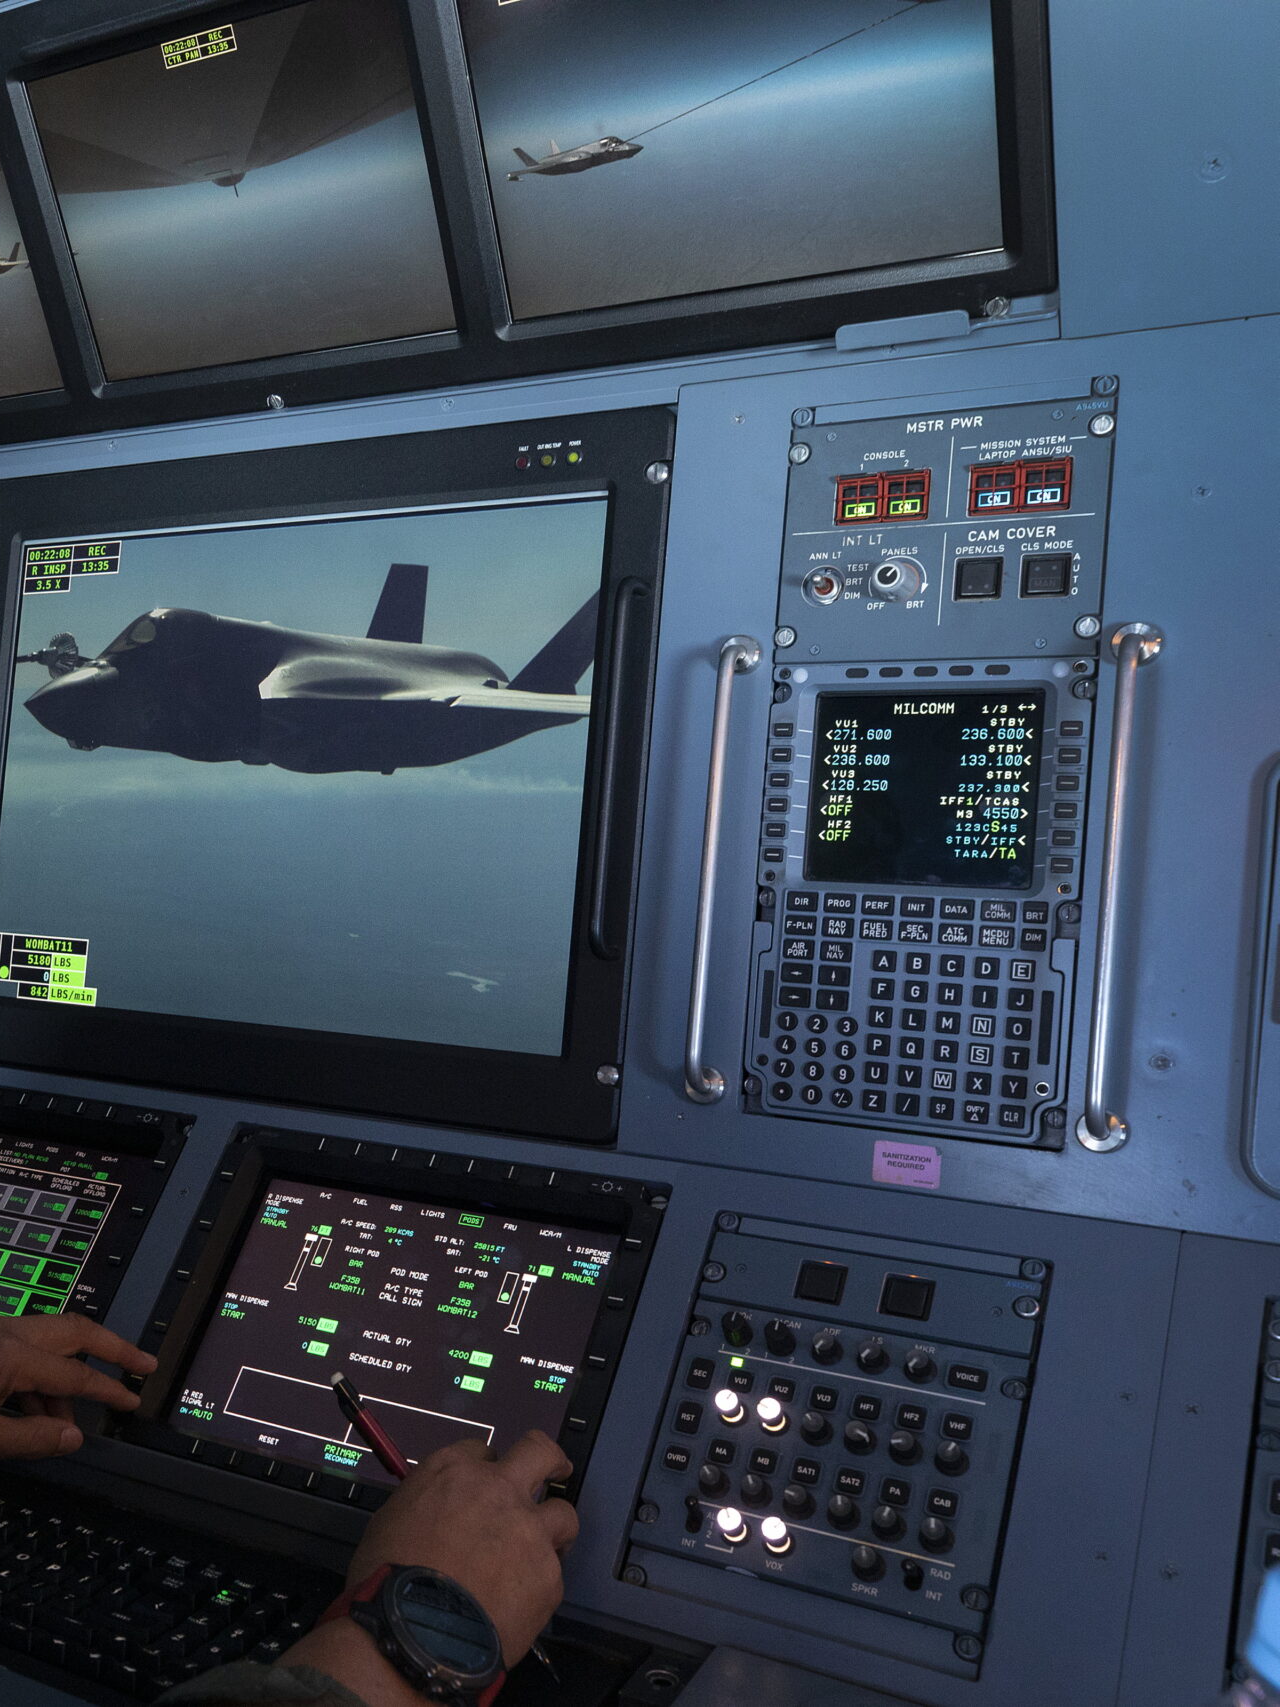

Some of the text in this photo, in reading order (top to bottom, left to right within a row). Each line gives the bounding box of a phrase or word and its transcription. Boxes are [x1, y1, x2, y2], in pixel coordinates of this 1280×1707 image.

[164, 31, 223, 54] 00:22:08 REC
[168, 41, 229, 65] CTR PAN 13:35
[906, 415, 983, 434] MSTR PWR
[980, 435, 1067, 451] MISSION SYSTEM
[863, 449, 906, 461] CONSOLE
[979, 445, 1073, 461] LAPTOP ANSU/SIU
[968, 525, 1057, 542] CAM COVER
[842, 534, 884, 547] INT LT
[1021, 540, 1074, 552] CLS MODE
[29, 546, 106, 561] 00:22:08 REC
[881, 547, 918, 557] PANELS
[955, 543, 1005, 555] OPEN/CLS
[809, 551, 842, 560] ANN LT
[32, 561, 109, 575] R INSP 13:35
[847, 563, 869, 572] TEST
[36, 579, 61, 590] 3.5 X
[845, 577, 863, 586] BRT
[844, 592, 861, 600] DIM
[867, 602, 885, 611] OFF
[906, 600, 925, 610] BRT
[893, 702, 1008, 715] MILCOMM 1/3
[835, 720, 859, 729] VU1
[990, 718, 1025, 727] STBY
[833, 744, 857, 753] VU2
[988, 744, 1024, 754] STBY
[832, 770, 855, 779] VU3
[986, 770, 1022, 780] STBY
[830, 795, 853, 804] HF1
[940, 794, 1020, 806] IFF1/TCAS
[956, 810, 974, 819] M3
[827, 820, 852, 829] HF2
[954, 847, 1017, 860] TARA/TA
[794, 896, 809, 906] DIR
[827, 898, 851, 909] PROG
[865, 901, 889, 910] PERF
[907, 903, 926, 912] INIT
[945, 905, 968, 915] DATA
[1026, 911, 1044, 921] BRT
[786, 920, 813, 930] F-PLN
[983, 928, 1010, 939] MCDU
[1025, 932, 1042, 942] DIM
[25, 938, 73, 952] WOMBAT11
[982, 936, 1009, 946] MENU
[28, 954, 71, 967] 5180 LBS
[43, 971, 70, 983] 0 LBS
[30, 986, 92, 1002] 842 LBS/min
[1003, 1111, 1019, 1123] CLR
[882, 1151, 932, 1164] SANITIZATION
[887, 1160, 925, 1171] REQUIRED
[352, 1198, 368, 1206] FUEL
[390, 1204, 403, 1212] RSS
[420, 1209, 445, 1219] LIGHTS
[260, 1217, 288, 1229] MANUAL
[462, 1216, 480, 1225] PODS
[340, 1218, 353, 1227] A/C
[355, 1221, 377, 1231] SPEED:
[397, 1228, 415, 1237] KCAS
[503, 1222, 518, 1231] FRU
[434, 1235, 506, 1254] STD ALT: 25815 FT
[344, 1245, 380, 1258] RIGHT POD
[348, 1259, 364, 1268] BAR
[390, 1267, 429, 1281] POD MODE
[454, 1266, 489, 1279] LEFT POD
[561, 1272, 596, 1285] MANUAL
[328, 1282, 366, 1296] WOMBAT11
[384, 1283, 424, 1297] A/C TYPE
[458, 1281, 475, 1290] BAR
[379, 1292, 423, 1307] CALL SIGN
[221, 1308, 245, 1320] START
[437, 1304, 478, 1319] WOMBAT12
[362, 1330, 412, 1347] ACTUAL QTY
[448, 1349, 470, 1360] 4200
[349, 1352, 412, 1374] SCHEDULED QTY
[520, 1356, 575, 1374] MAN DISPENSE
[692, 1367, 708, 1378] SEC
[955, 1372, 980, 1383] VOICE
[533, 1379, 565, 1393] START
[734, 1376, 748, 1386] VU1
[774, 1384, 789, 1394] VU2
[949, 1421, 967, 1431] VHF
[258, 1434, 280, 1446] RESET
[324, 1443, 362, 1459] PRIMARY
[667, 1452, 687, 1463] OVRD
[797, 1466, 816, 1477] SAT1
[840, 1476, 861, 1487] SAT2
[933, 1497, 952, 1508] CAB
[766, 1560, 784, 1571] VOX
[851, 1582, 879, 1597] SPKR
